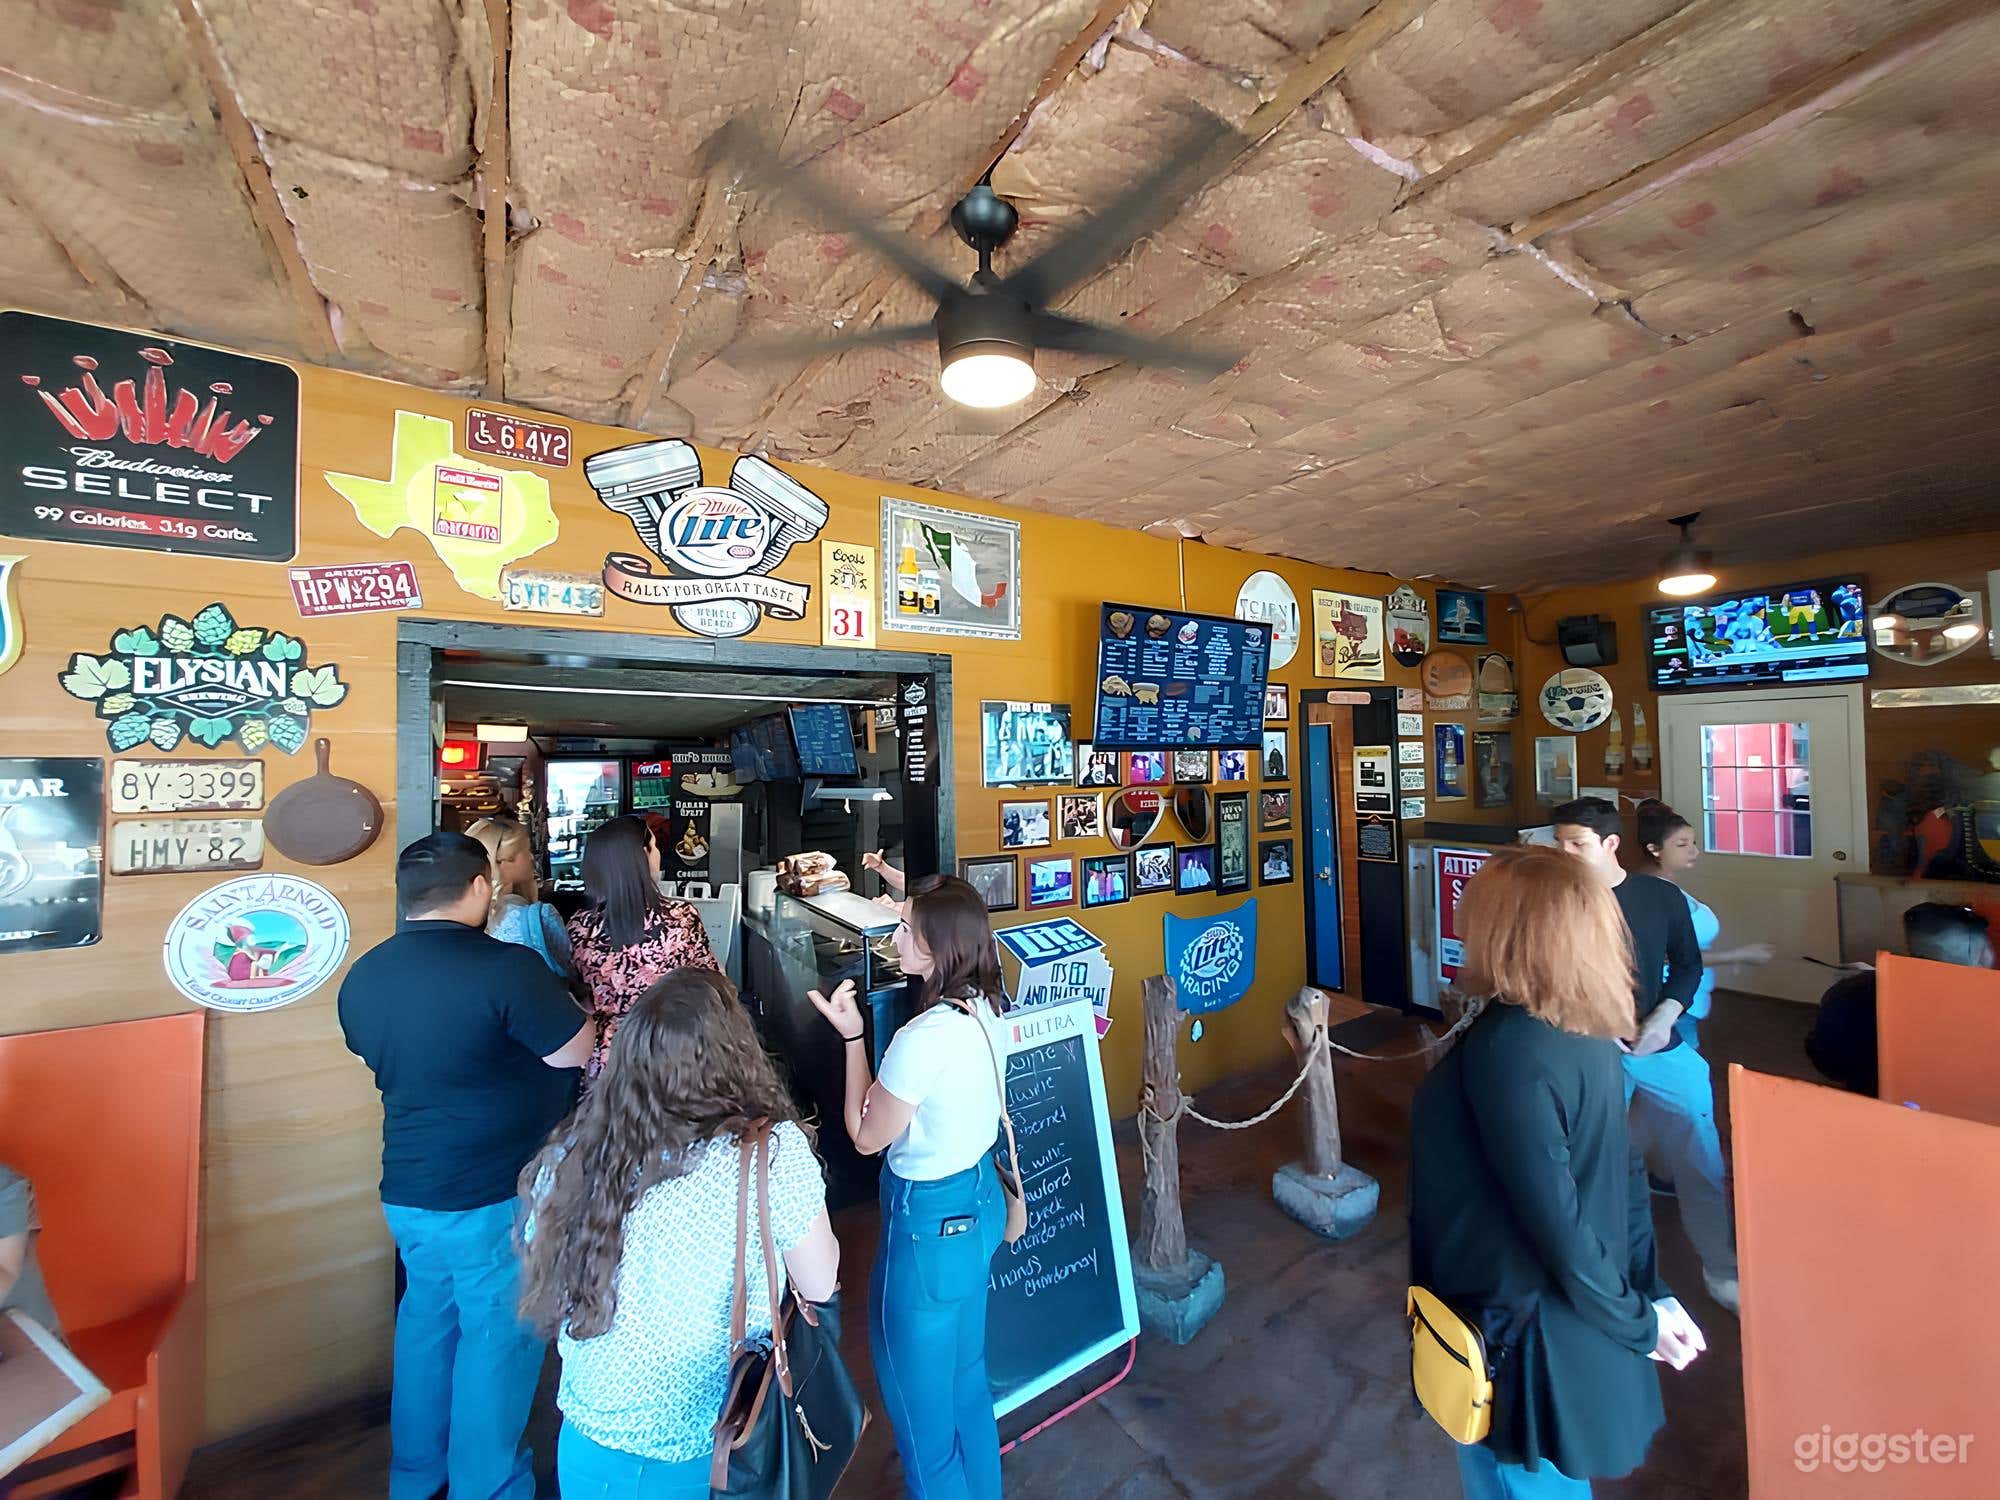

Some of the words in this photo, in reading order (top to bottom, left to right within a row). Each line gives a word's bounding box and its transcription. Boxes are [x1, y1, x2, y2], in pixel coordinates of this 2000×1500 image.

[66, 446, 233, 482] Budweiser
[22, 465, 273, 514] SELECT
[34, 505, 64, 521] 99
[675, 514, 762, 548] Lite
[361, 573, 411, 602] 294
[622, 578, 671, 597] RALLY
[753, 583, 795, 604] TASTE
[833, 608, 864, 638] 31
[132, 656, 287, 698] ELYSIAN
[0, 778, 69, 797] TAR
[1000, 924, 1087, 960] Lite
[1183, 958, 1241, 997] RACING
[1023, 984, 1048, 1006] AND
[1023, 1013, 1075, 1039] ULTRA
